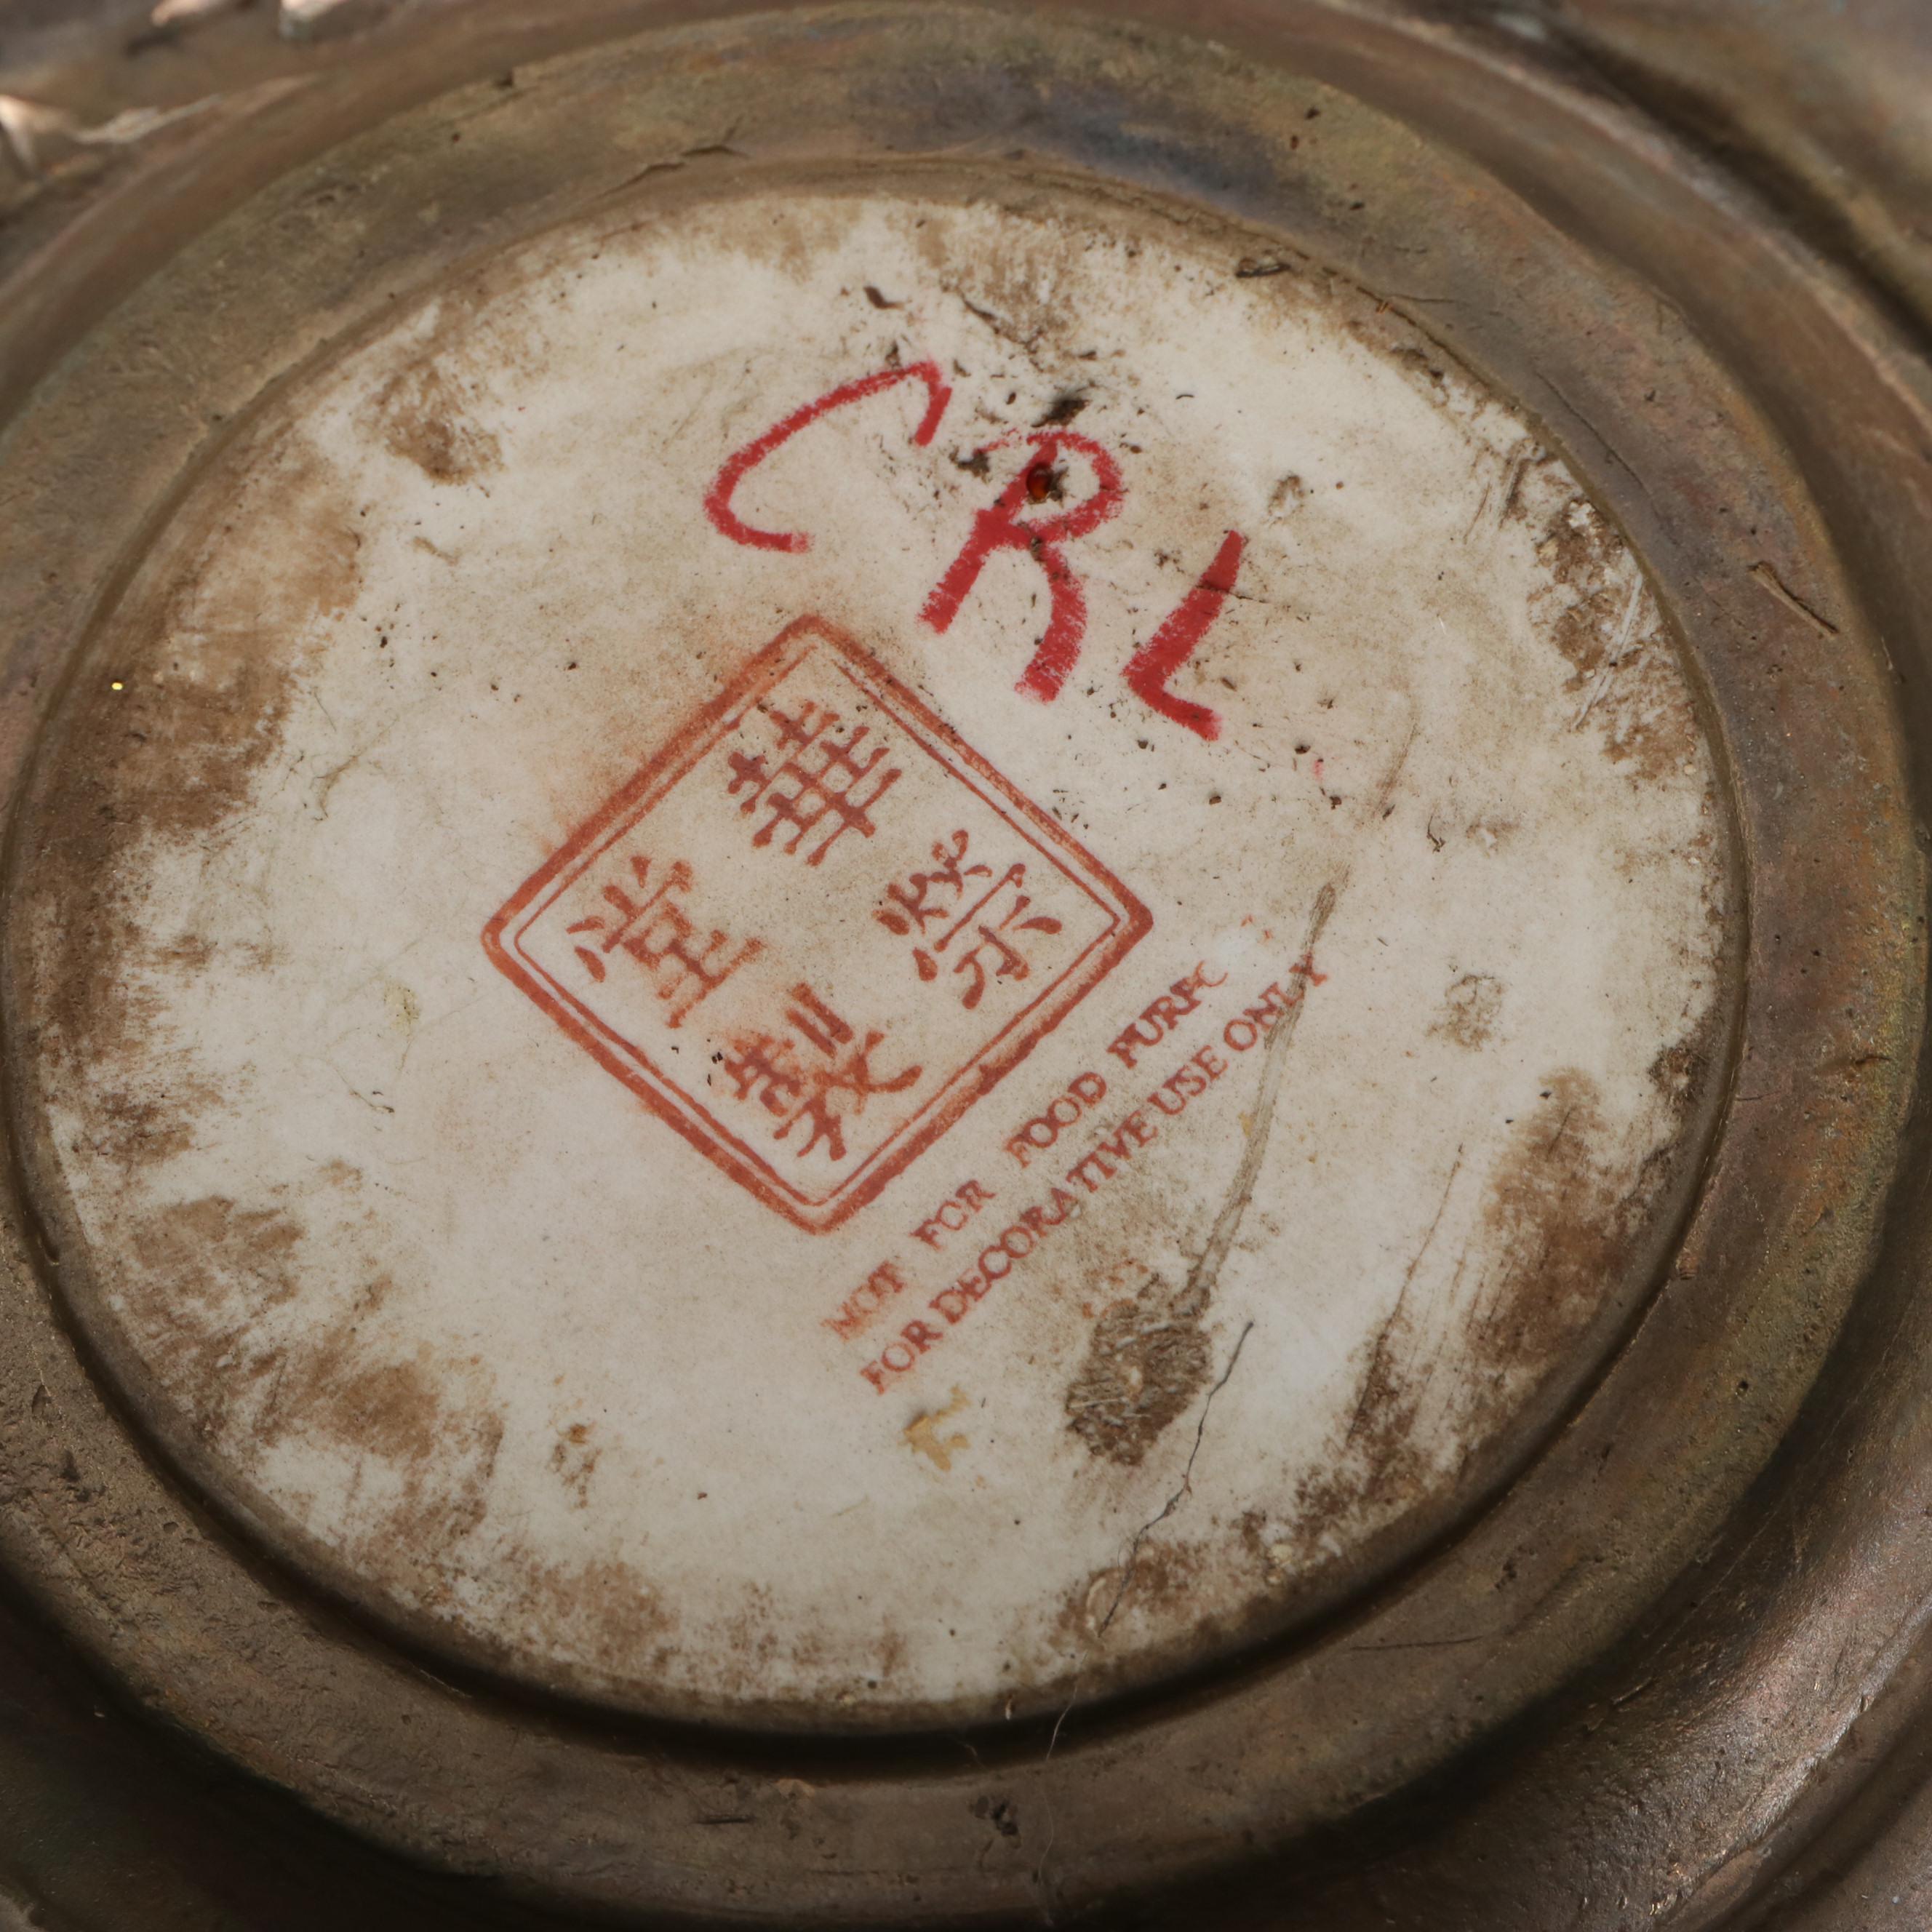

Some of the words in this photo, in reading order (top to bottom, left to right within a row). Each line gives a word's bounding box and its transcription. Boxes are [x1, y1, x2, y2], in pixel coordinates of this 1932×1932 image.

[703, 359, 1248, 741] CRL
[821, 1260, 906, 1342] NOT
[910, 1179, 995, 1250] FOR
[1004, 1071, 1107, 1167] FOOD
[859, 1320, 943, 1394] FOR
[929, 1109, 1159, 1325] DECORATIVE
[1147, 1045, 1229, 1116] USE
[1223, 950, 1329, 1052] ONLY
